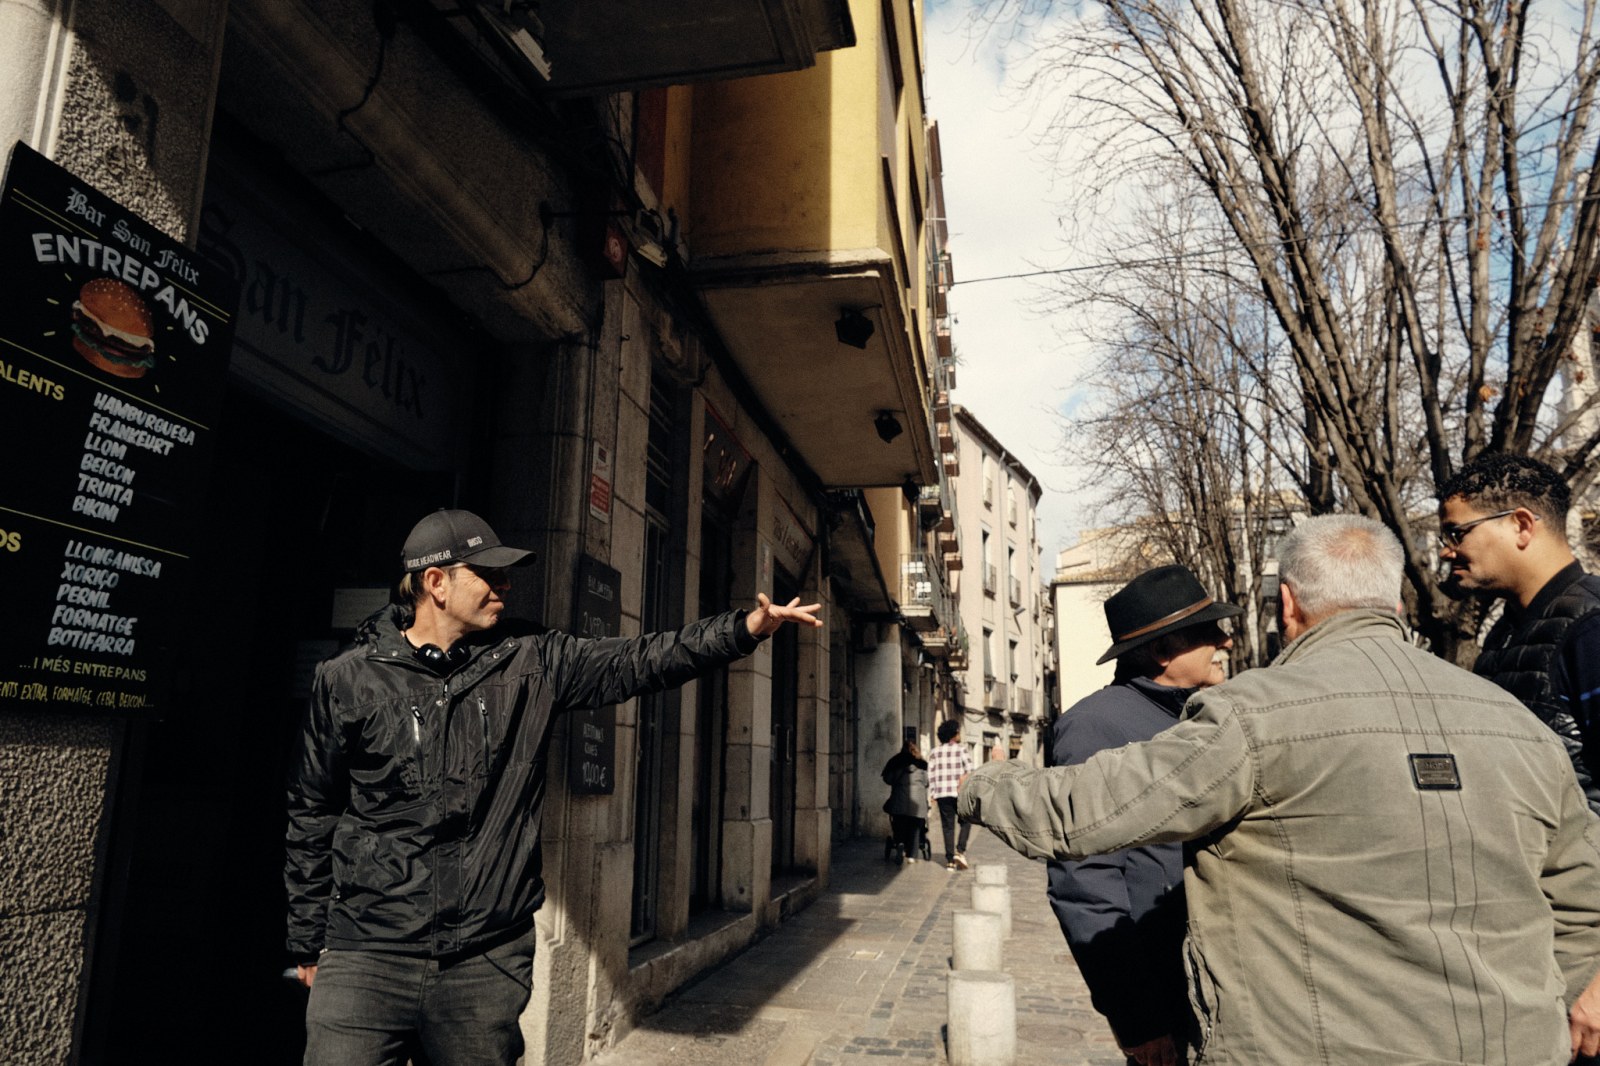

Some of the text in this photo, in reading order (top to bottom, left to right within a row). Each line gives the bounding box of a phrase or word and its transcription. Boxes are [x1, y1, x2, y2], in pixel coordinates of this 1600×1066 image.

[65, 187, 200, 286] Bar San Felix
[32, 233, 210, 345] ENTREPANS
[93, 392, 196, 446] HAMBURGUESA
[83, 432, 128, 460] LLOM
[80, 452, 136, 485] BEICON
[77, 472, 134, 507] TRUITA
[72, 495, 120, 523] BIKINI
[64, 539, 162, 579] LLONGANISSA
[420, 549, 452, 565] HEADWEAR
[60, 561, 120, 590] XORIÇO
[55, 583, 111, 609] PERNIL
[51, 604, 139, 636] FORMATGE
[47, 627, 136, 656] BOTIFARRA
[41, 654, 70, 673] MÉS
[73, 661, 147, 682] ENTREPANS
